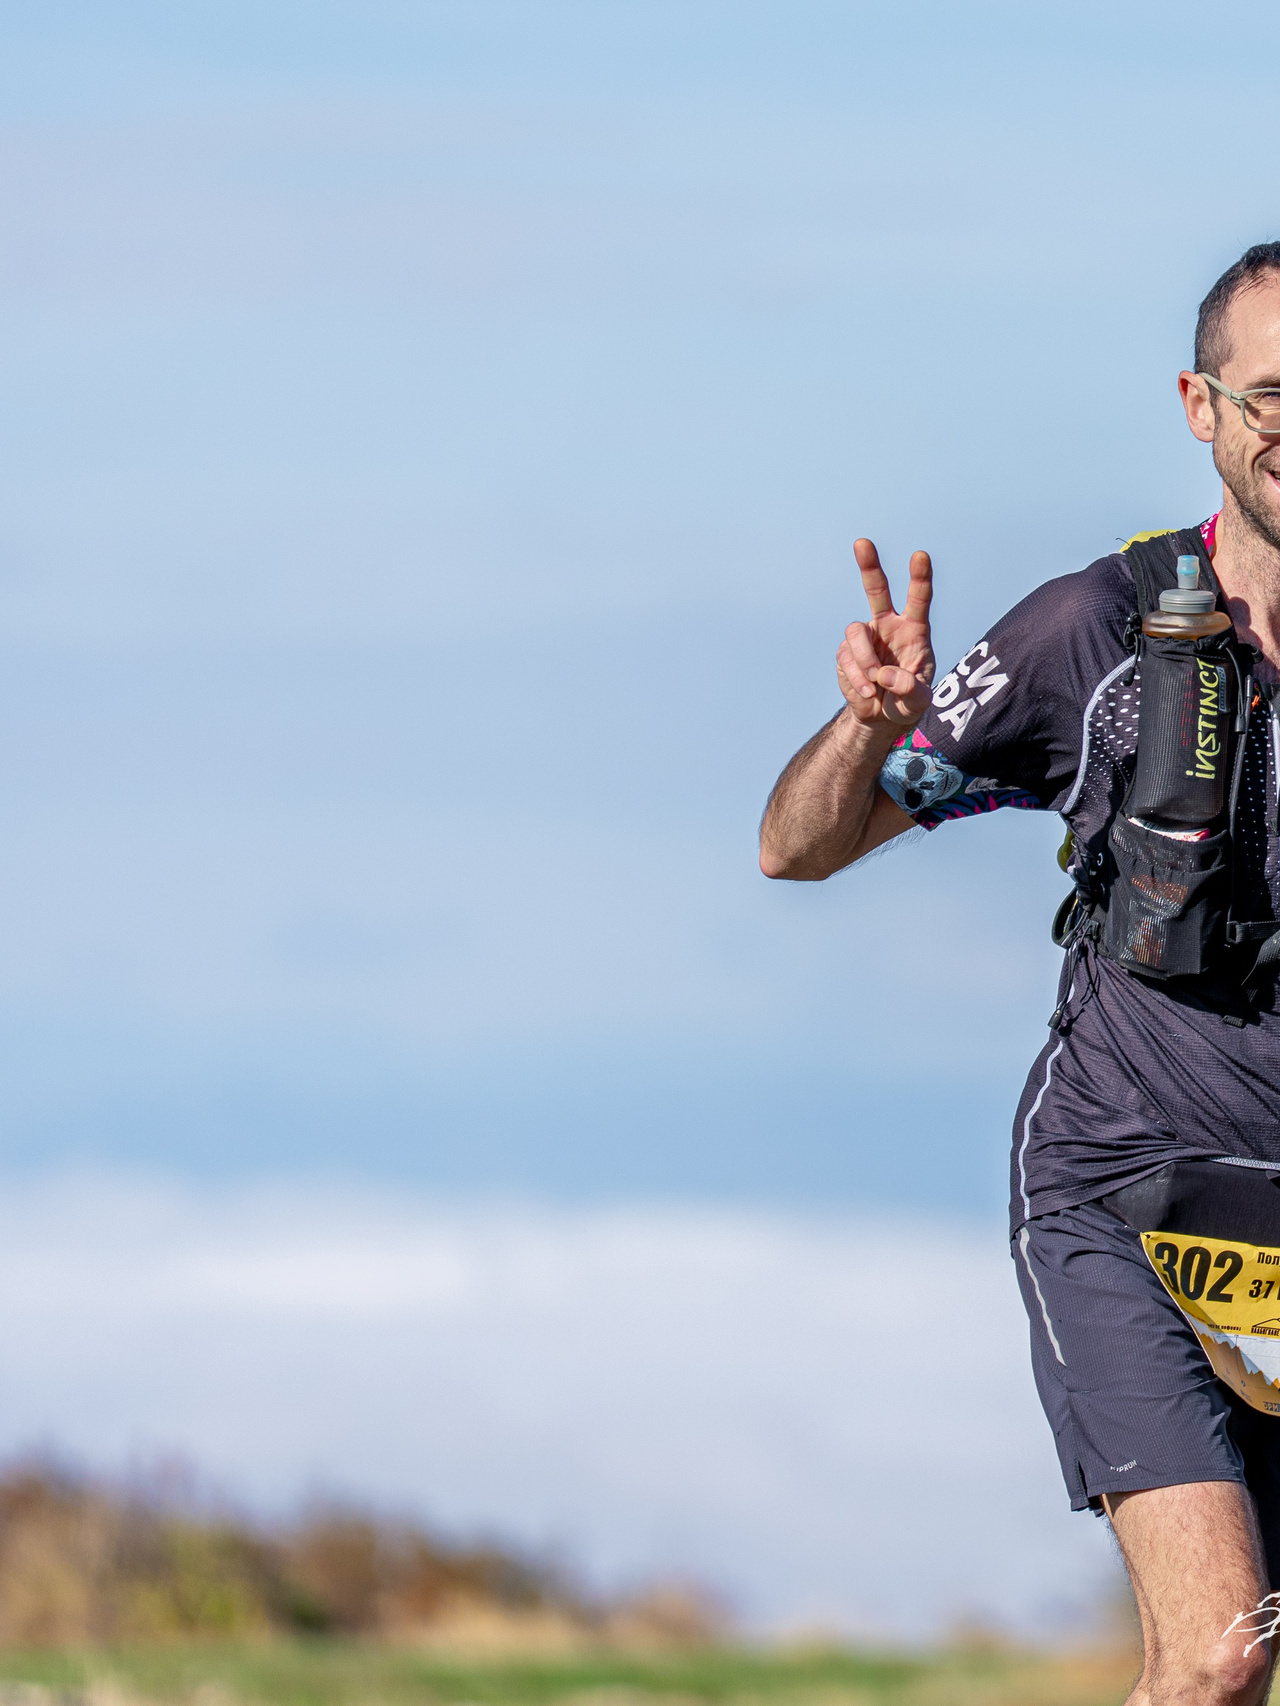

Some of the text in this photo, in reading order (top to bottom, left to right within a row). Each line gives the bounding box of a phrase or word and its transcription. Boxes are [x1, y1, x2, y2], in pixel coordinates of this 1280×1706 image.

[1155, 1242, 1243, 1303] 302
[1249, 1279, 1275, 1299] 37
[1110, 1459, 1138, 1472] KIPRUN
